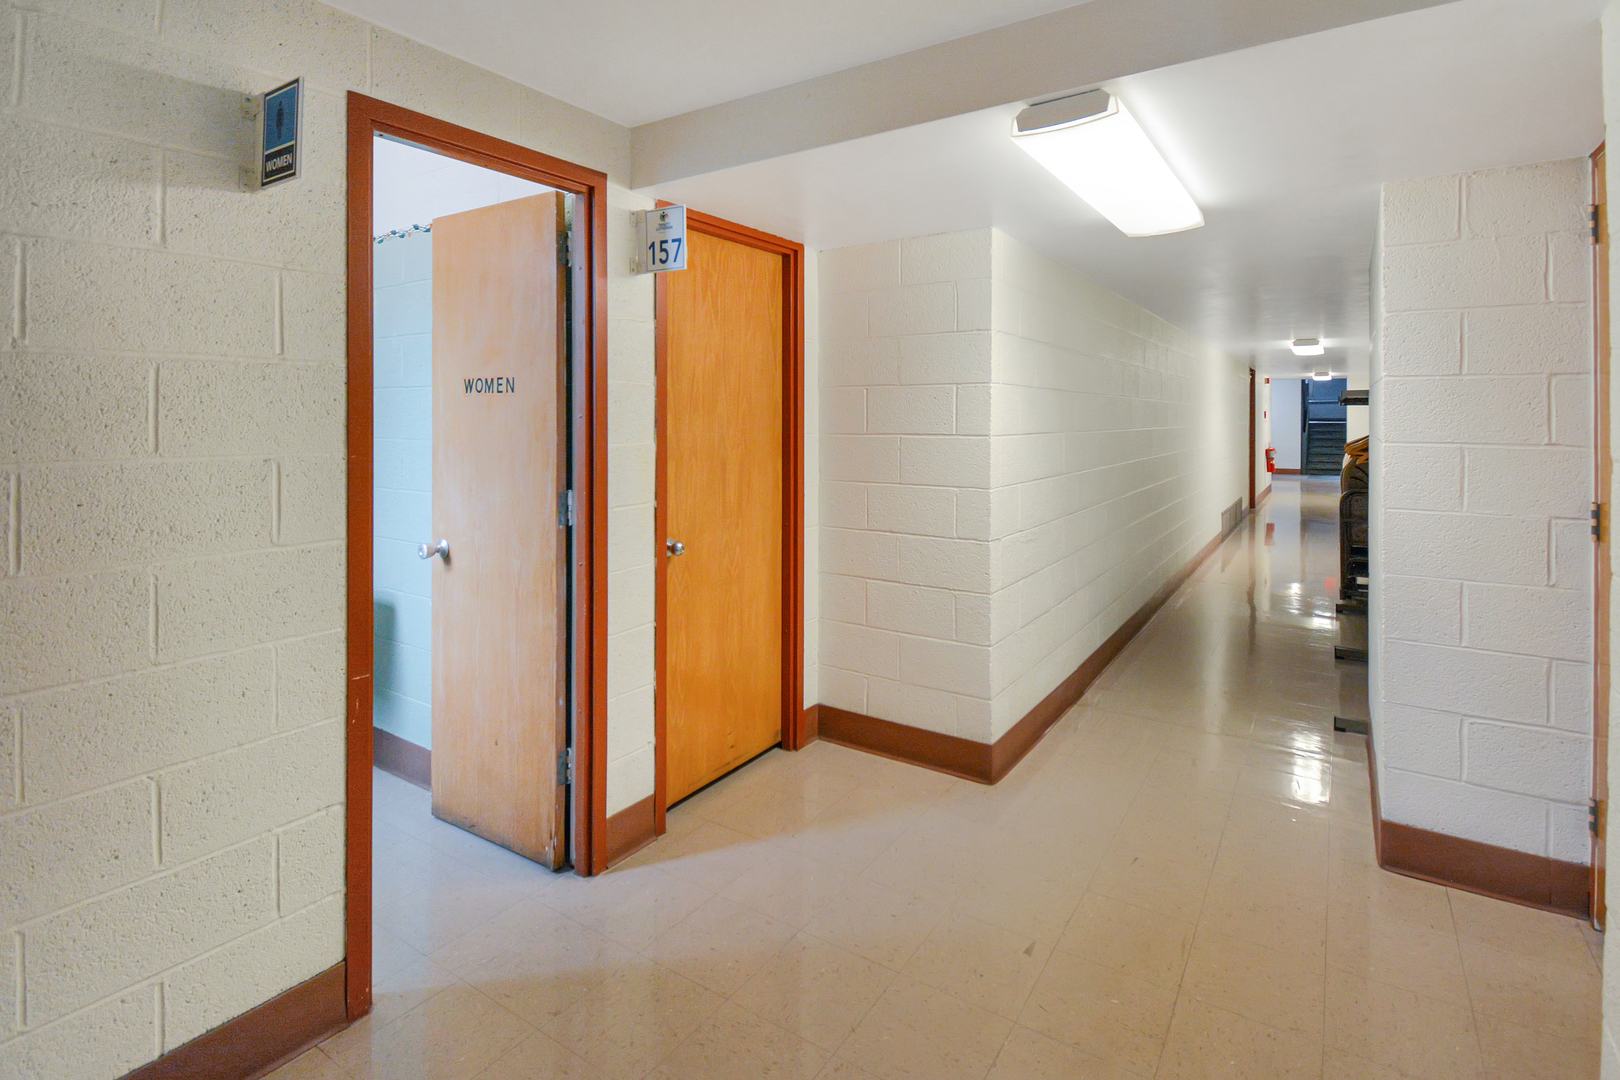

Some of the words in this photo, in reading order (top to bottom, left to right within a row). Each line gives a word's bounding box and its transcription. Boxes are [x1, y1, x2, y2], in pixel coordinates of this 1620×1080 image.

[266, 153, 293, 172] WOMEN
[649, 237, 682, 265] 157
[464, 377, 515, 394] WOMEN
